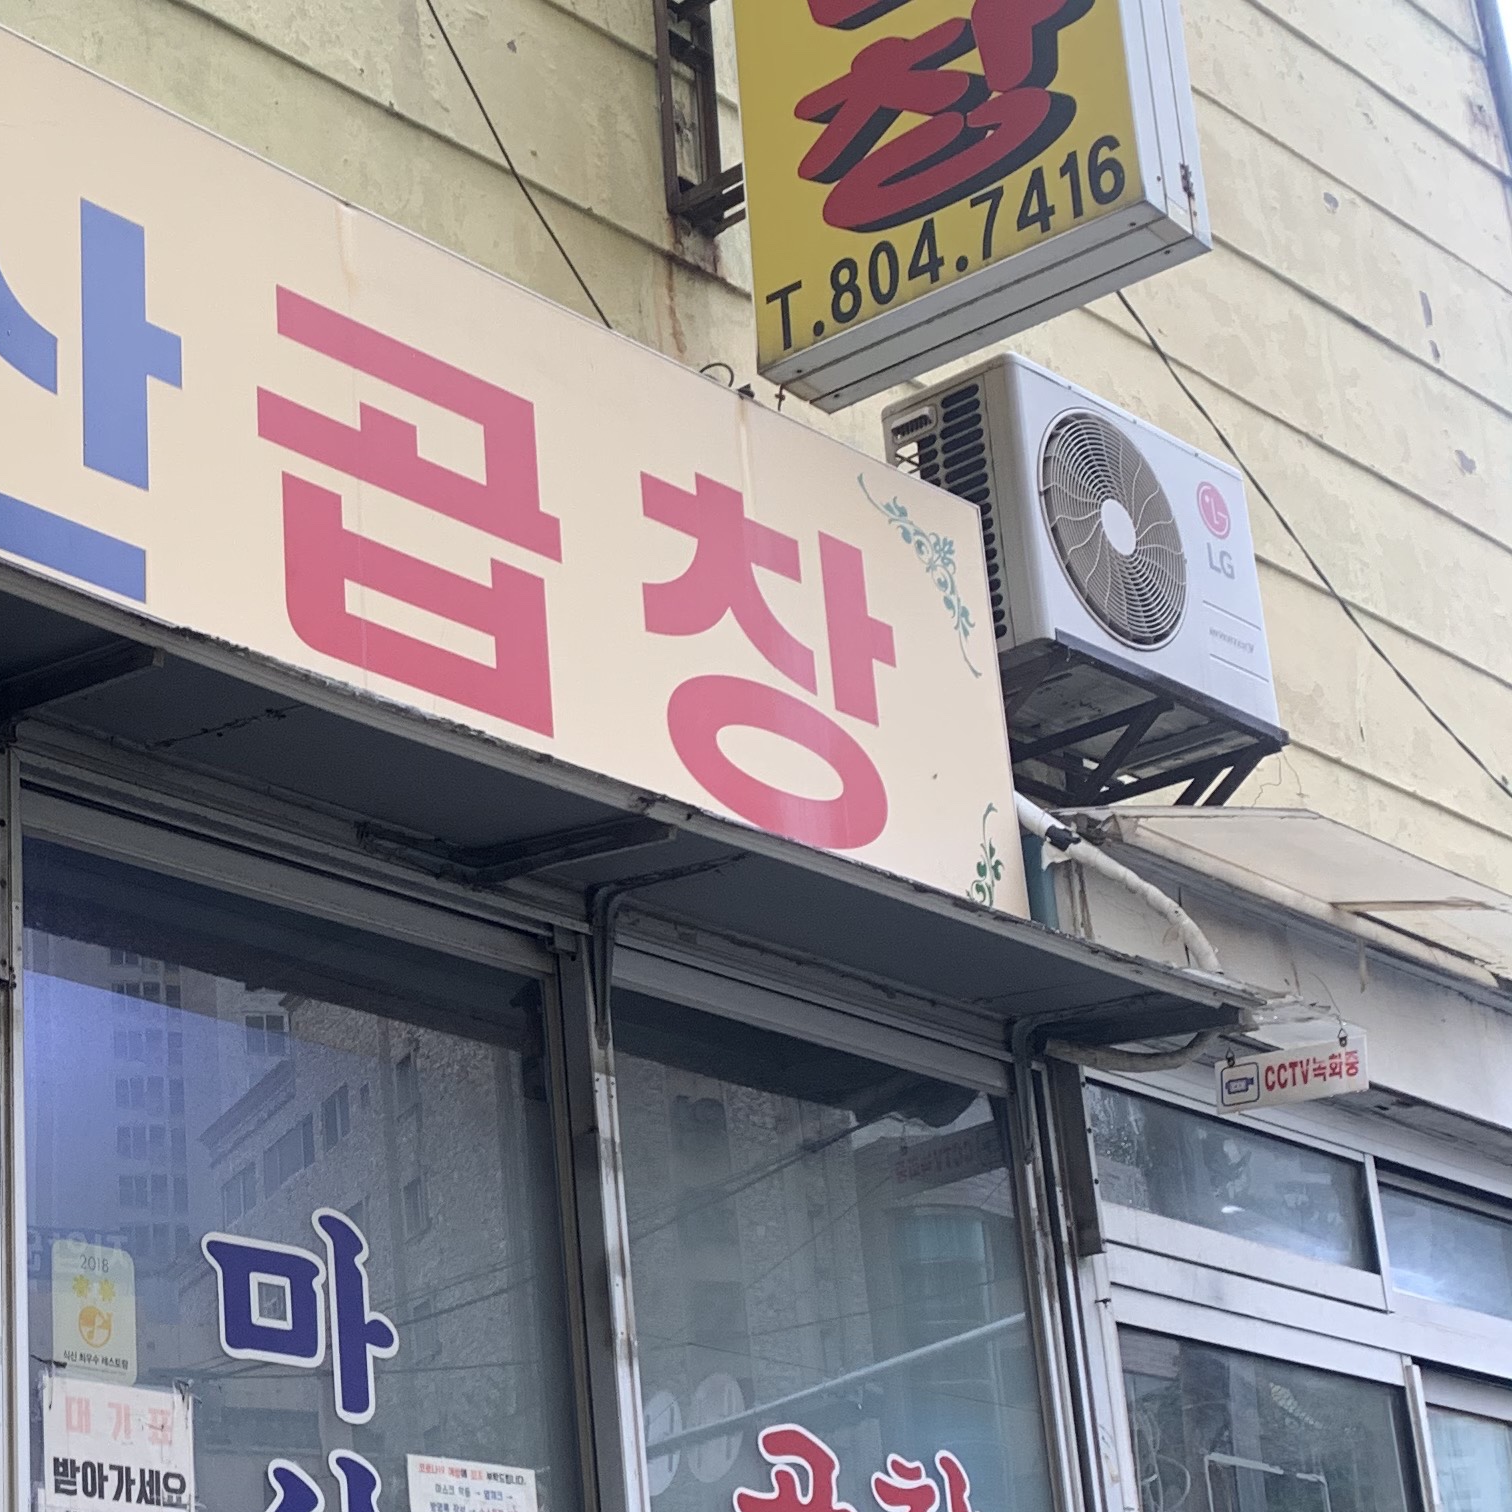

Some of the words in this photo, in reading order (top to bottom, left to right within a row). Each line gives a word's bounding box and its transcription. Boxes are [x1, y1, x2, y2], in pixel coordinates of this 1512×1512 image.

[766, 135, 1126, 351] T.804.7416
[1206, 542, 1235, 580] LG
[79, 1254, 110, 1274] 2018
[79, 1351, 99, 1364] 최우수
[53, 1456, 188, 1511] 받아가세요
[435, 1483, 455, 1495] 마스크
